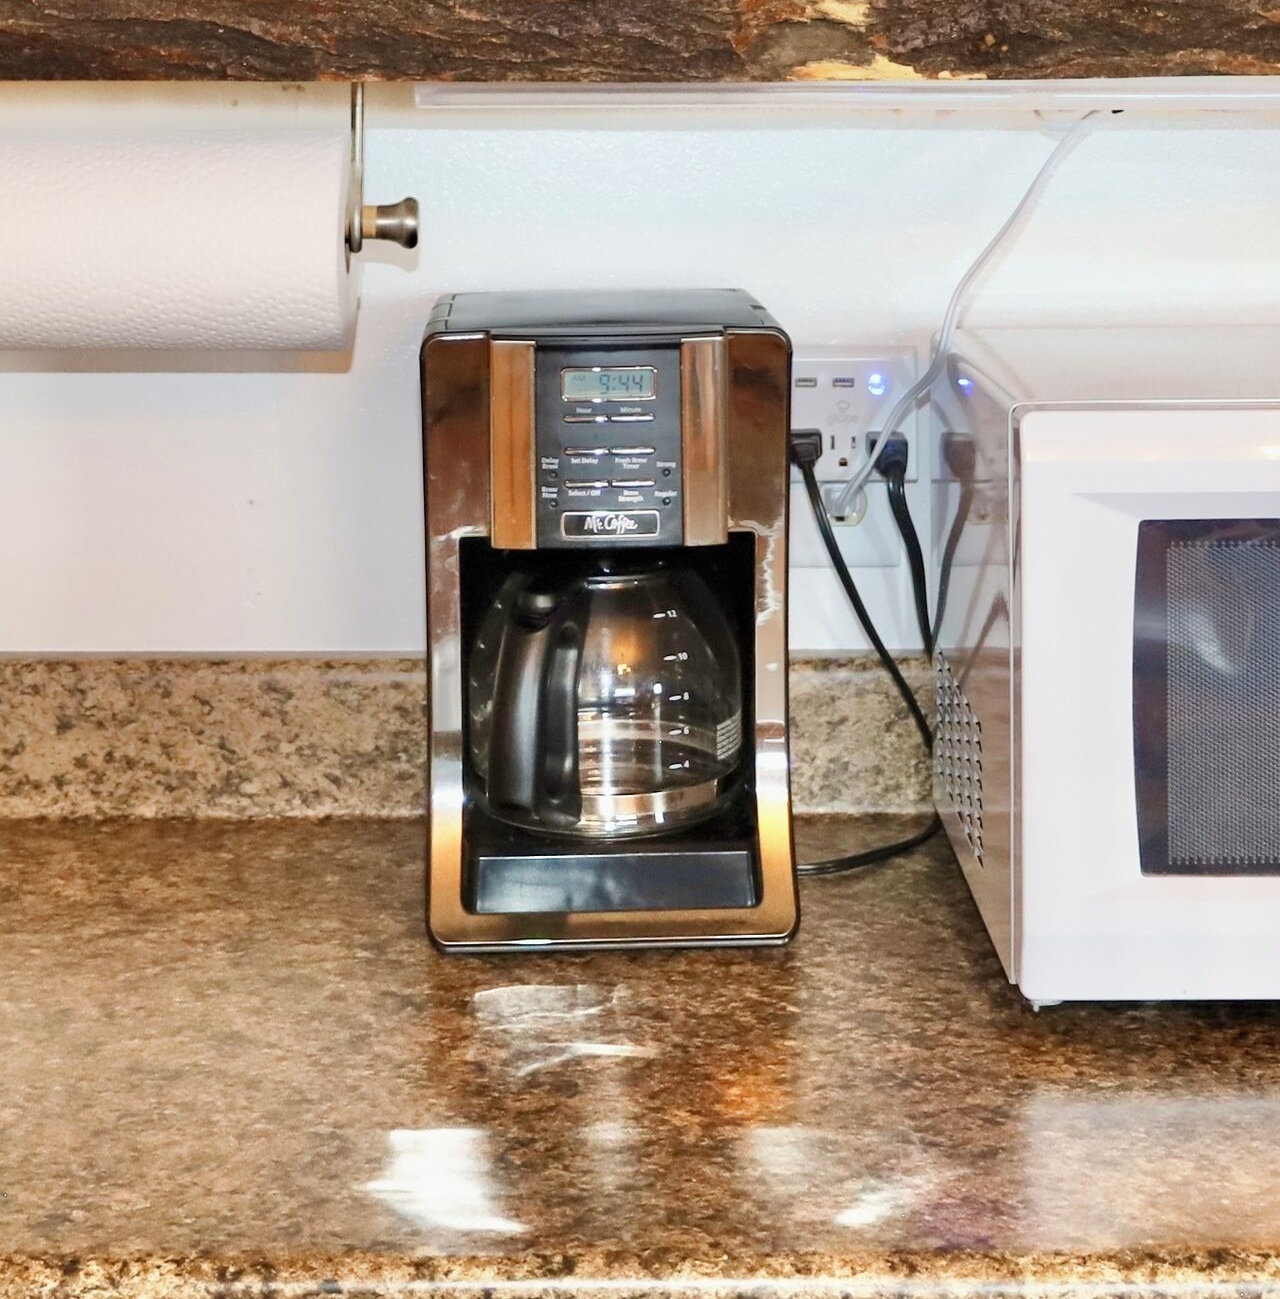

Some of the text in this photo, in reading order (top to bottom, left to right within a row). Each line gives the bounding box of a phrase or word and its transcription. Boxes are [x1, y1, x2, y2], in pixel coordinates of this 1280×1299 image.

[598, 374, 644, 395] 9:44
[604, 514, 639, 534] Coffee
[666, 609, 677, 618] 12
[678, 651, 688, 661] 10
[683, 726, 689, 735] 6
[683, 759, 690, 768] 4
